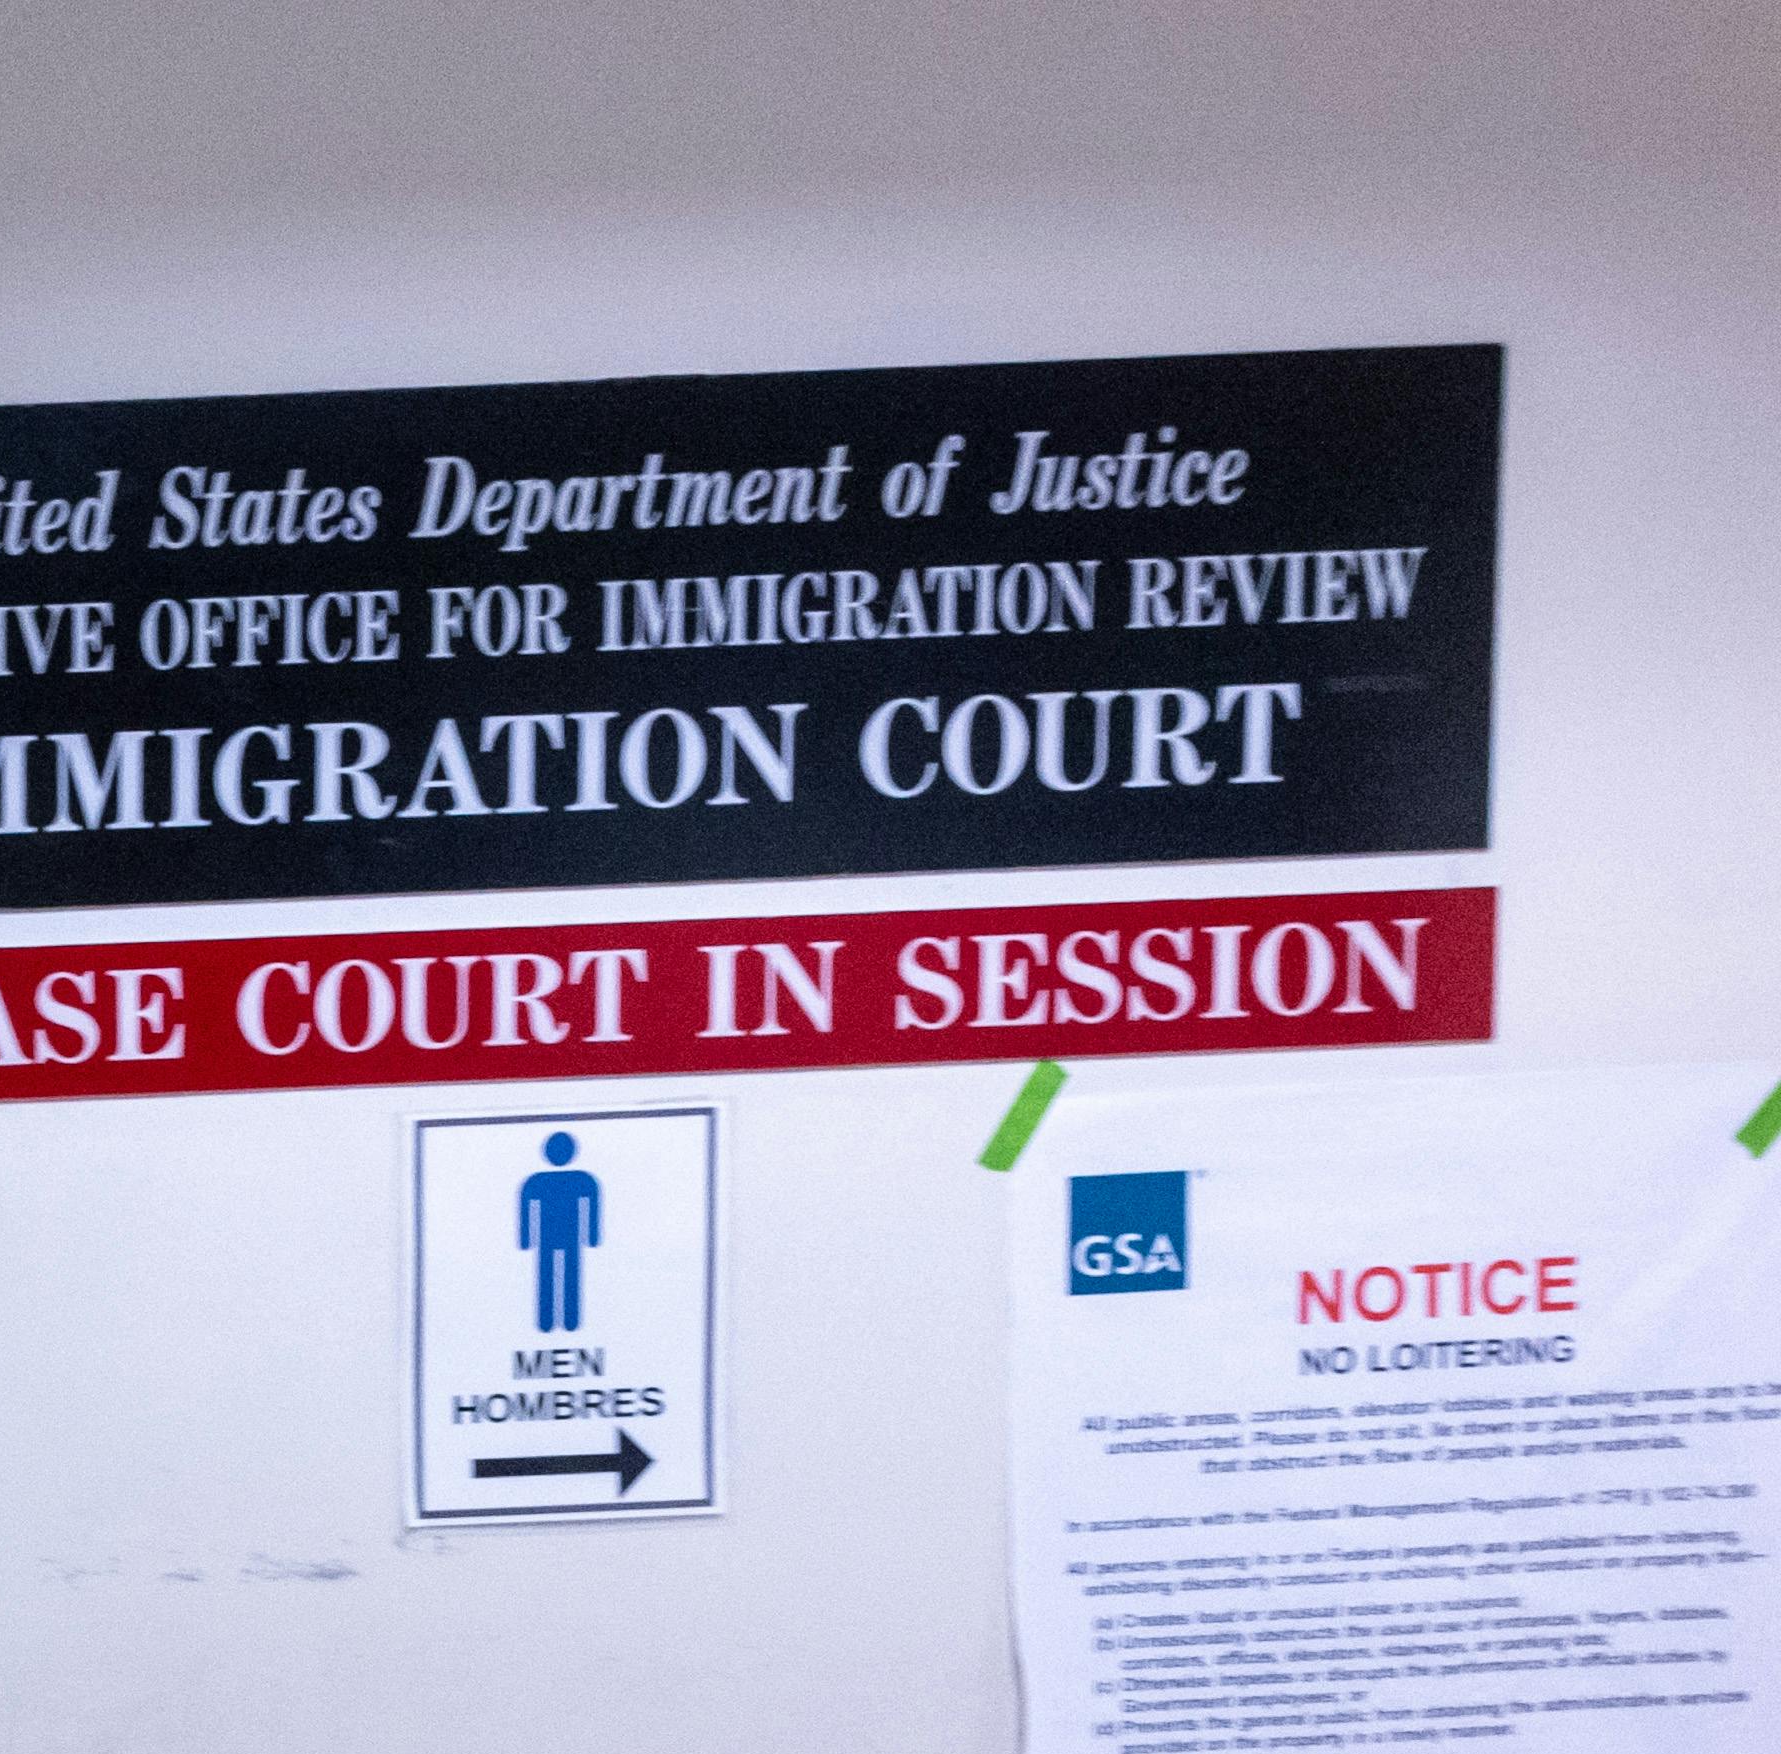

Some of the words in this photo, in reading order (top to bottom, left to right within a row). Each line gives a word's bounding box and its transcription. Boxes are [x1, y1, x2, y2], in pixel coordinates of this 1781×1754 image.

[148, 465, 384, 550] States
[408, 445, 851, 551] Department
[880, 434, 967, 520] of
[990, 425, 1250, 517] Justice
[138, 589, 400, 673] OFFICE
[426, 582, 571, 660] FOR
[595, 558, 1102, 652] IMMIGRATION
[1127, 546, 1429, 632] REVIEW
[859, 682, 1302, 800] COURT
[236, 948, 648, 1056] COURT
[694, 940, 844, 1040] IN
[894, 917, 1431, 1032] SESSION
[1072, 1232, 1183, 1278] GSA
[1297, 1256, 1579, 1325] NOTICE
[513, 1347, 606, 1379] MEN
[1298, 1346, 1358, 1375] NO
[1367, 1334, 1577, 1371] LOITERING
[451, 1386, 668, 1424] HOMBRES
